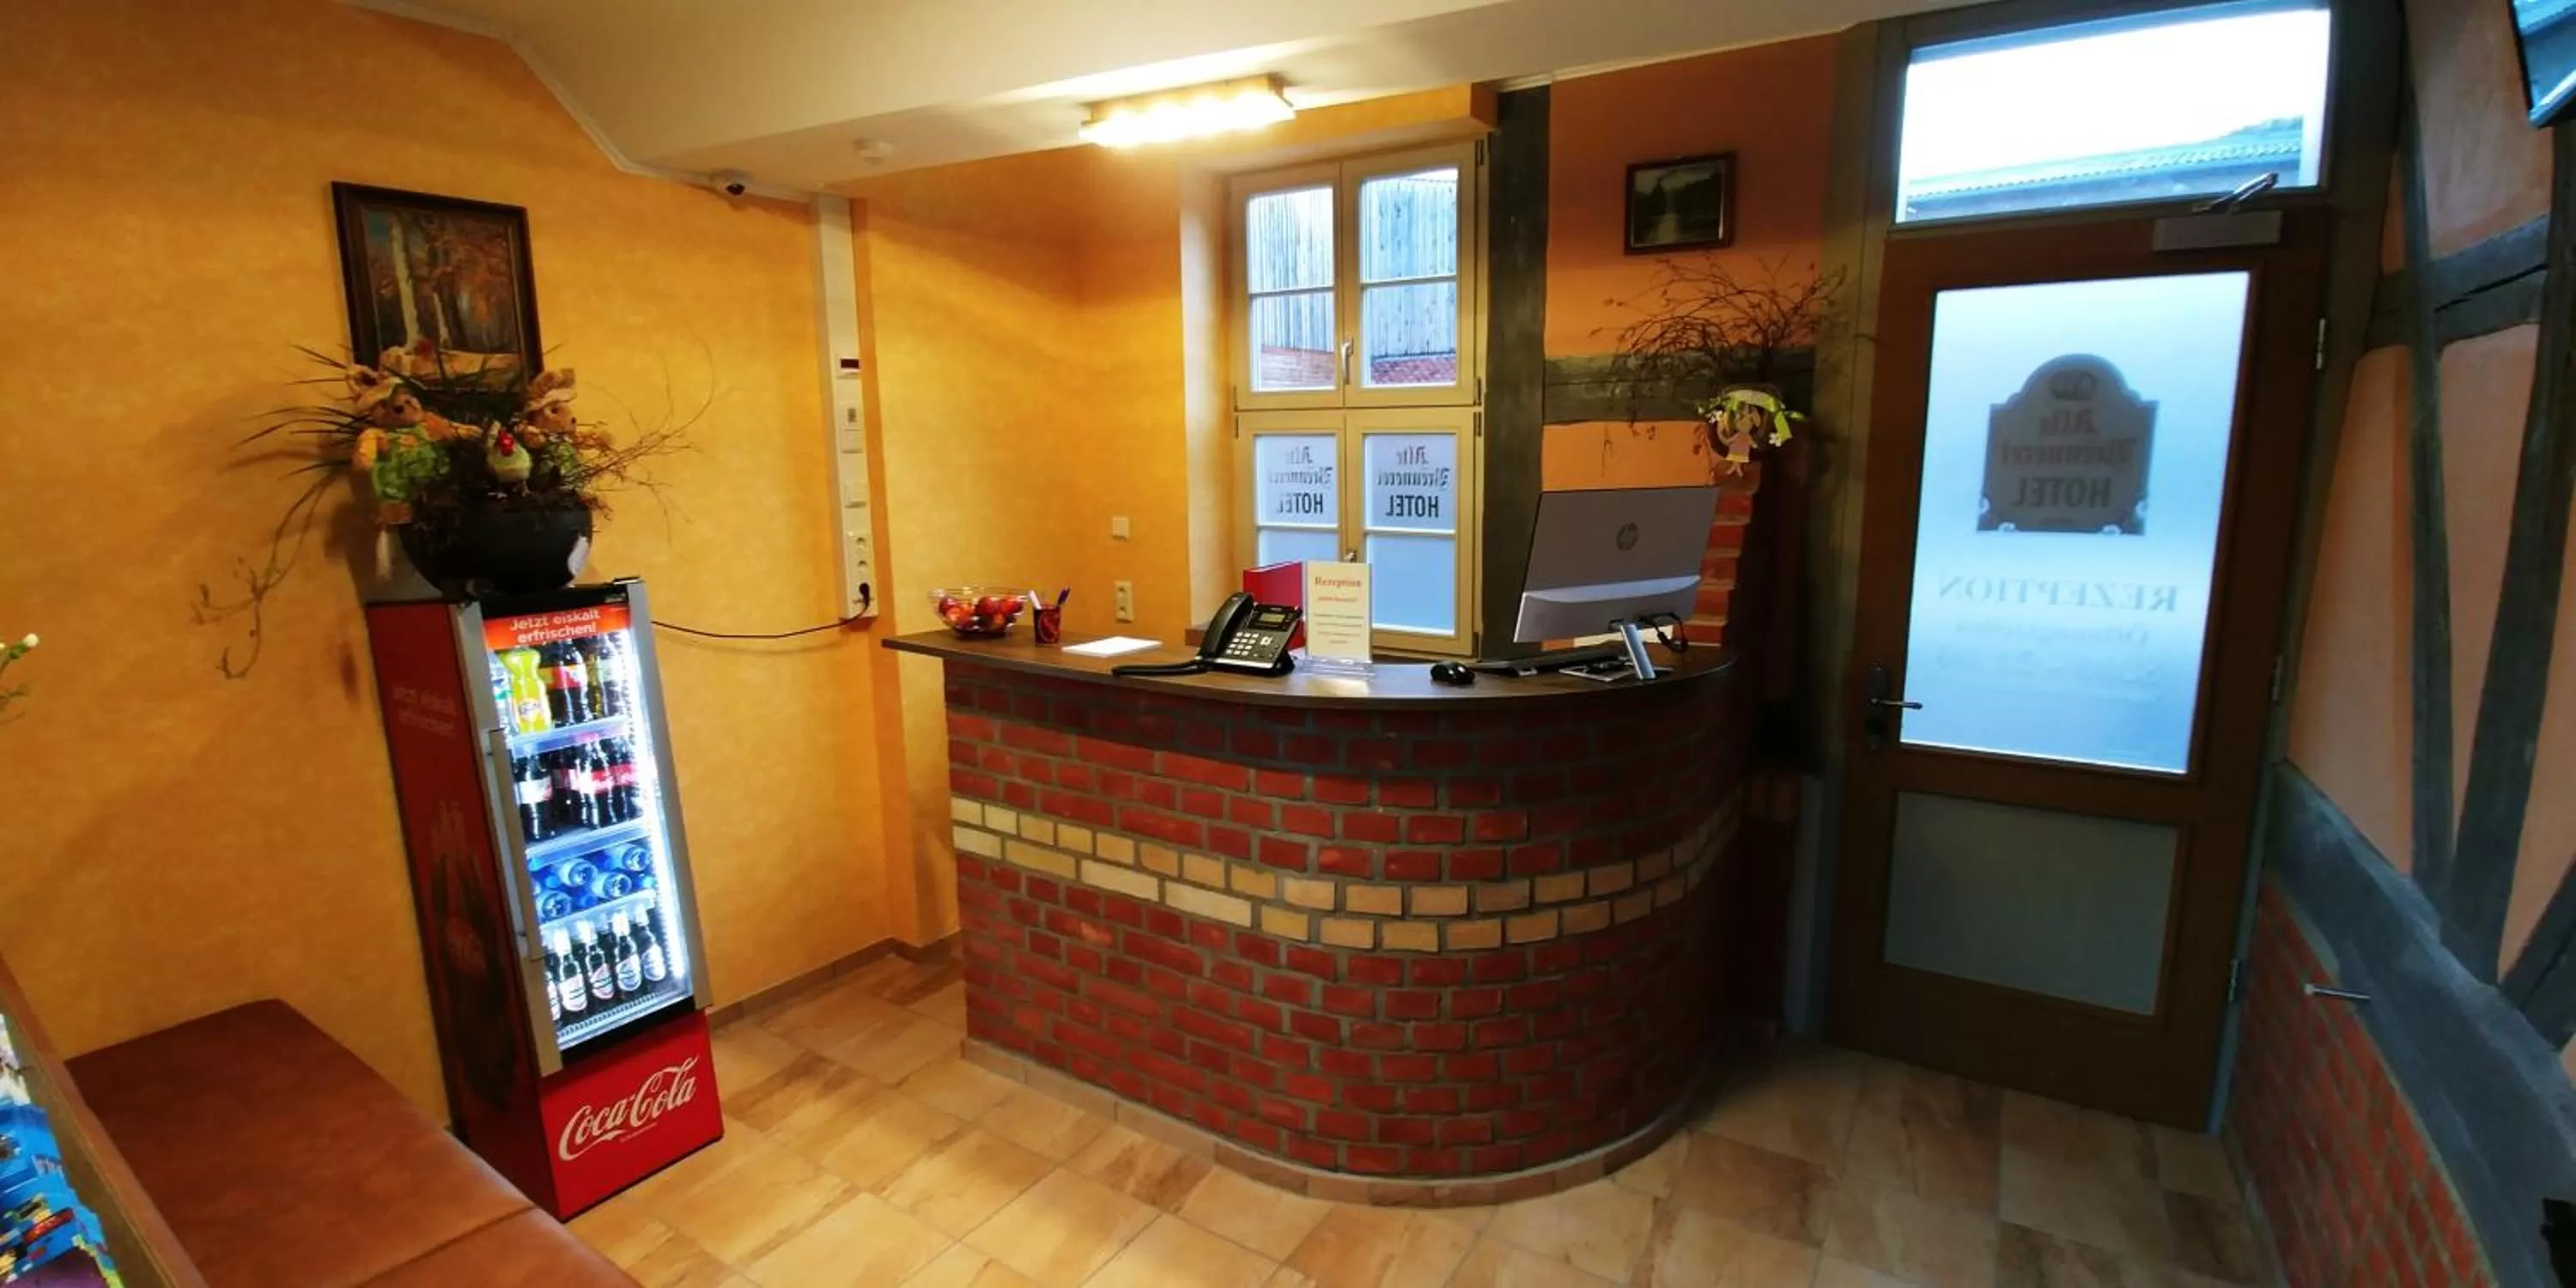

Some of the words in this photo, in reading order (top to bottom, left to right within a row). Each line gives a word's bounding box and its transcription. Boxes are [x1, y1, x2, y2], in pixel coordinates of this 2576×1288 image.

[510, 616, 549, 631] Jetzt
[553, 608, 600, 624] eiskalt
[517, 622, 596, 642] erfrischen!
[559, 1054, 699, 1161] Coca-Cola
